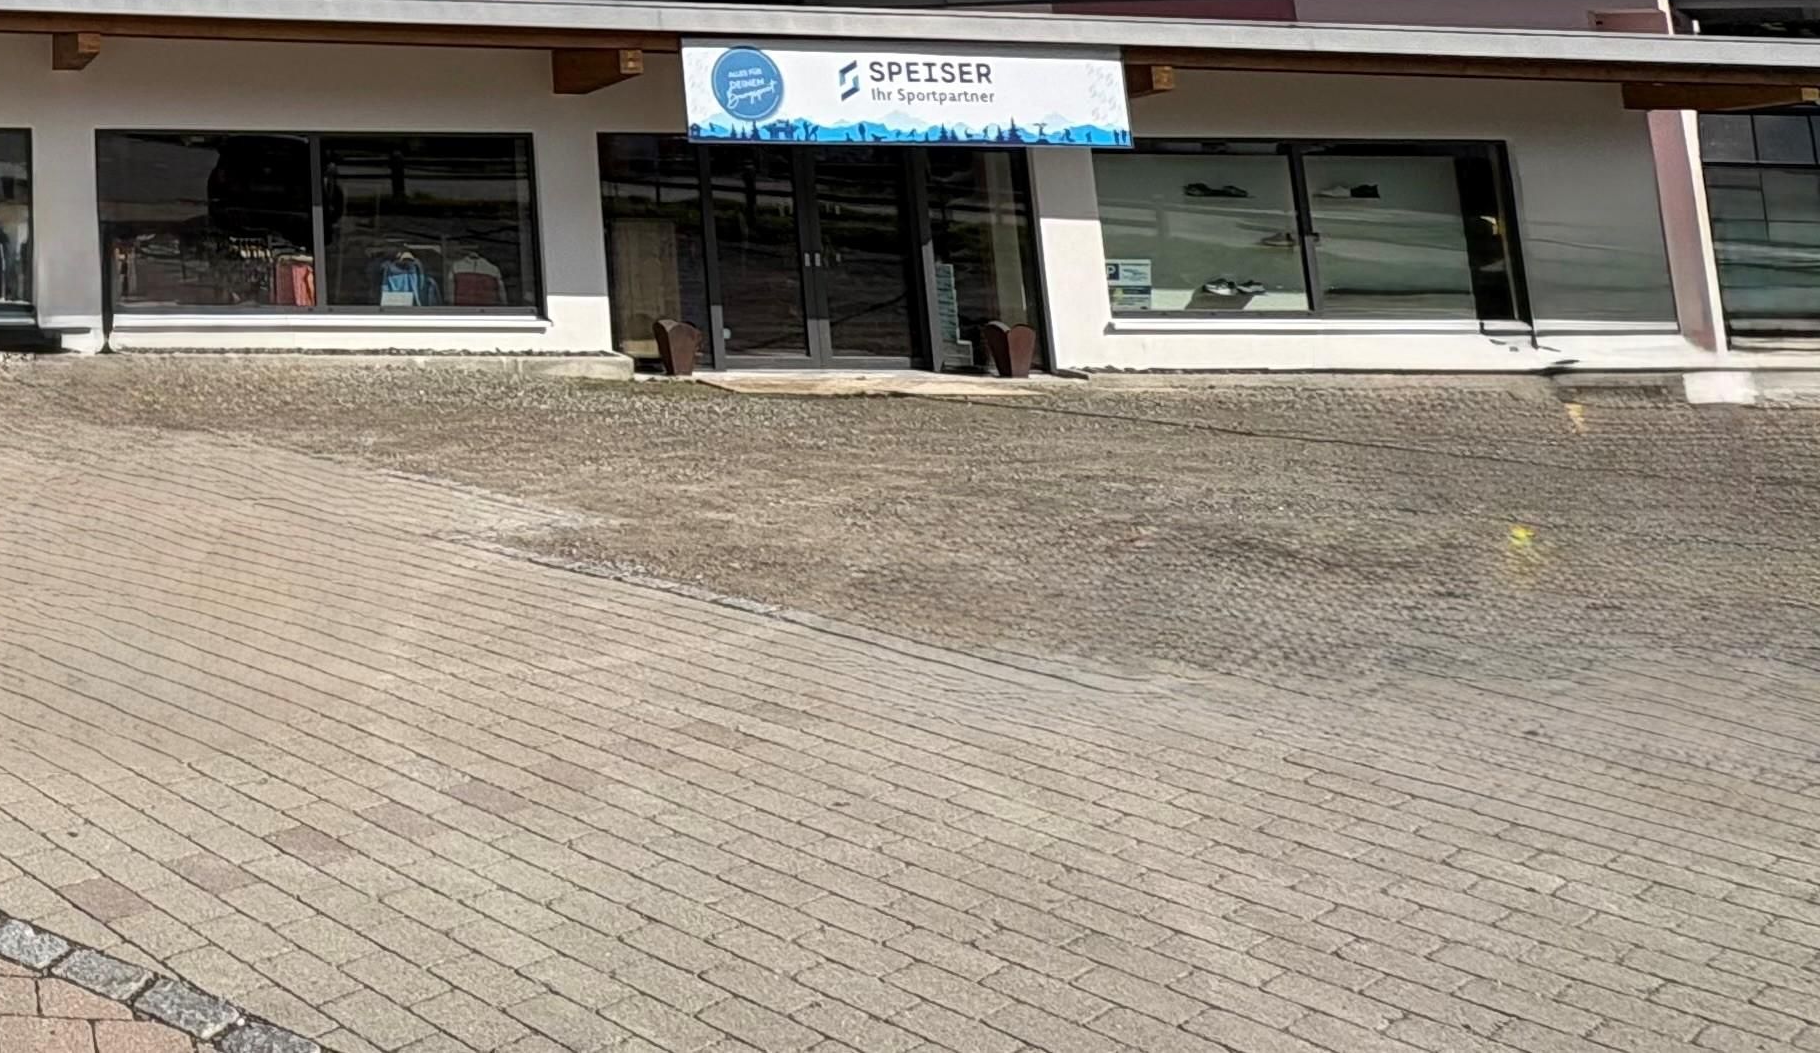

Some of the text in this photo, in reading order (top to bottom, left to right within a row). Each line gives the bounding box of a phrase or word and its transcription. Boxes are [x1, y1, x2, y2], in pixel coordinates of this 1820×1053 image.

[869, 61, 993, 84] SPEISER
[871, 87, 995, 105] Ihr Sportpartner
